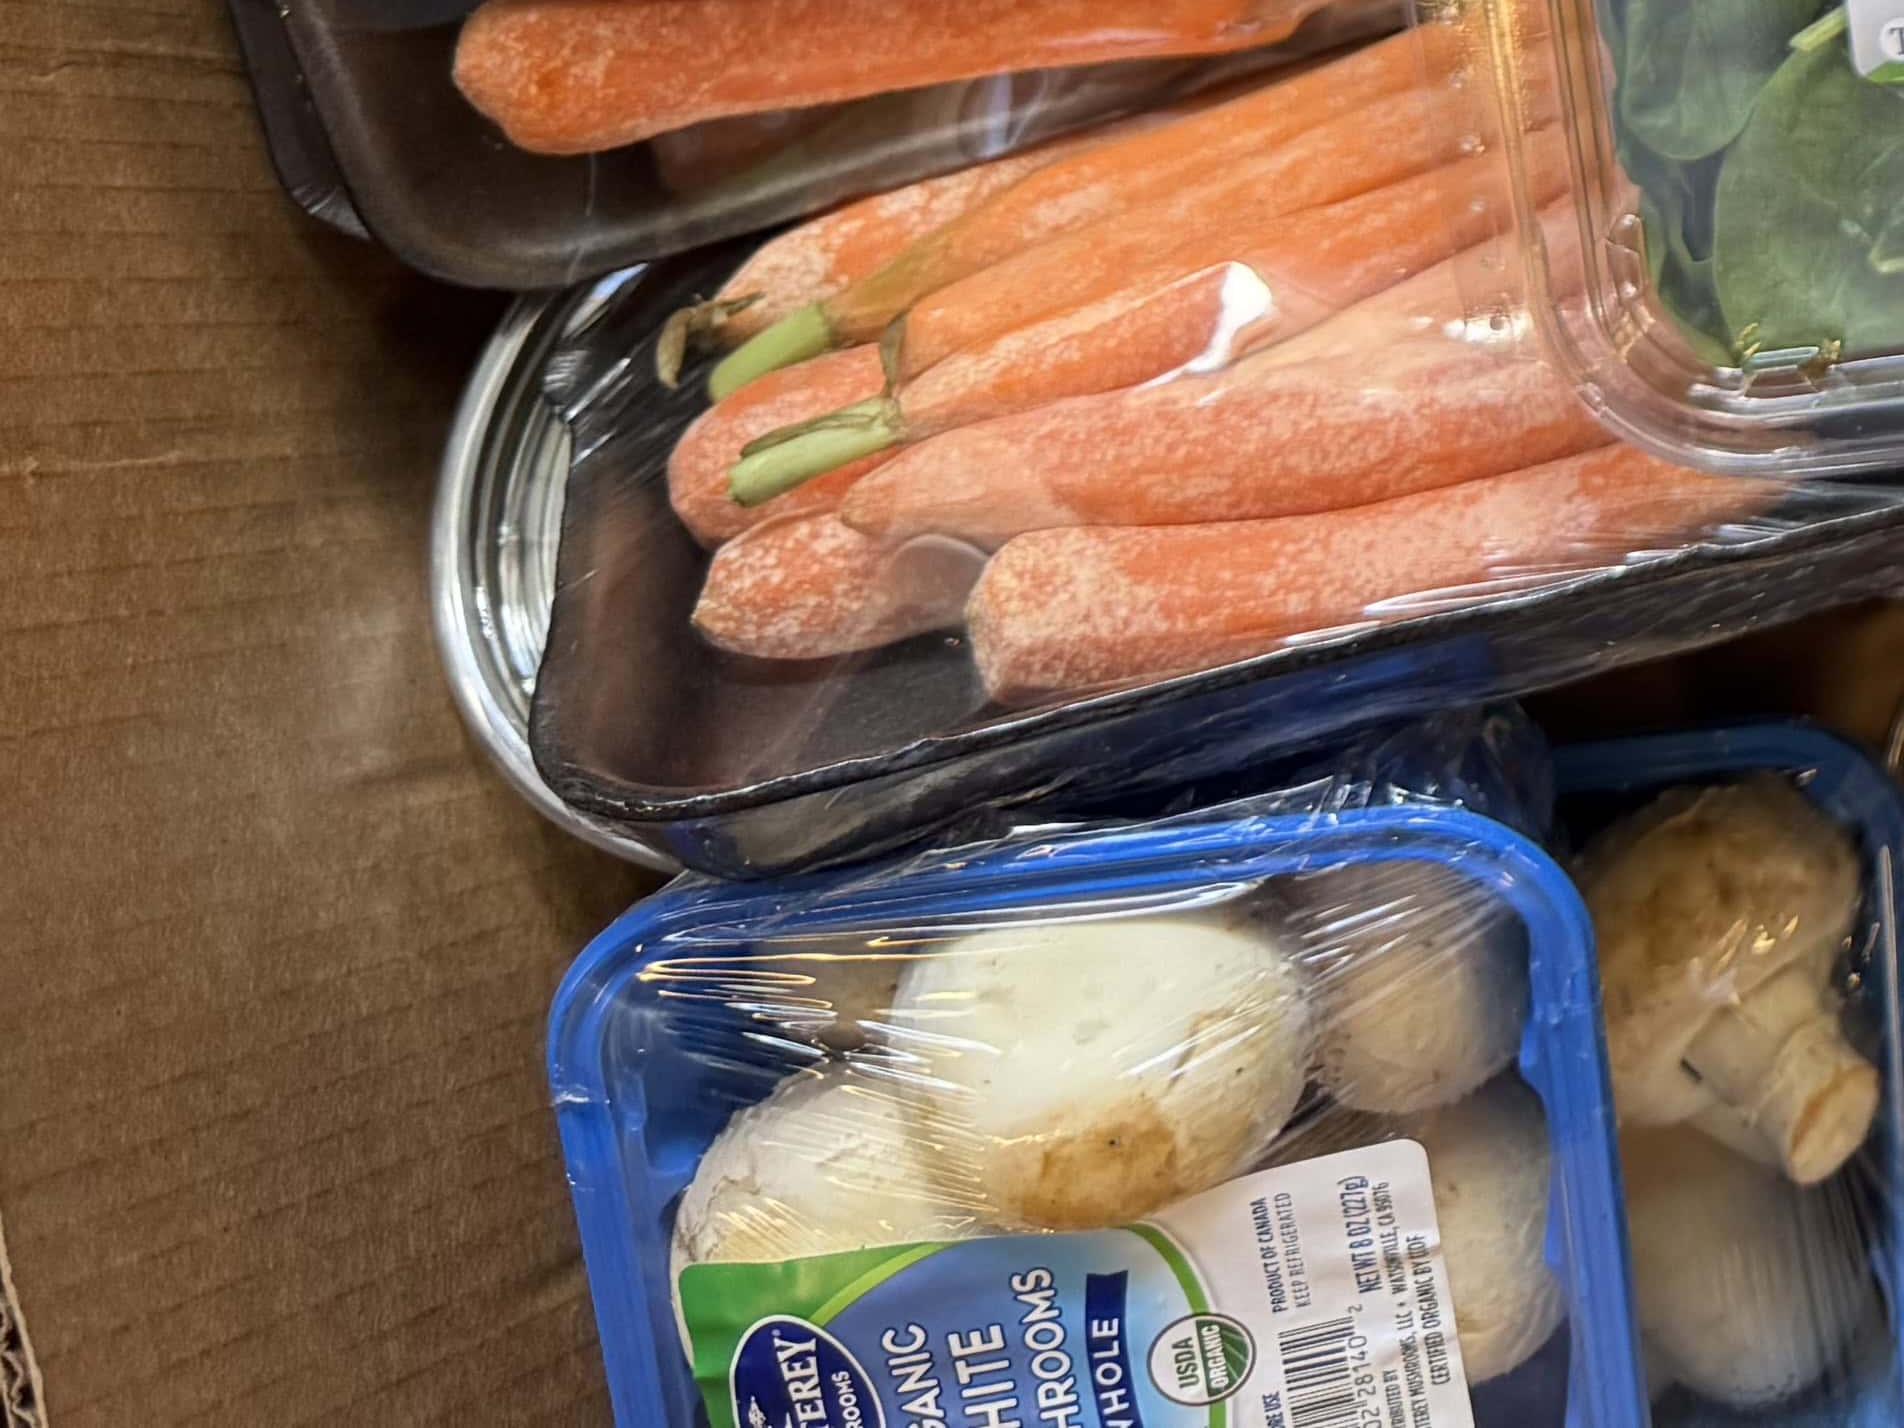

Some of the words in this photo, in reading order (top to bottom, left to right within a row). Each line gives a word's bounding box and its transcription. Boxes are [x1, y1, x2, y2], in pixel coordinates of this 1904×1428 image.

[1337, 1175, 1370, 1218] (227g)
[1249, 1197, 1273, 1243] CANADA
[1344, 1217, 1371, 1237] OZ
[1376, 1211, 1395, 1226] CA
[1274, 1193, 1298, 1276] REFRIGERATED
[1348, 1237, 1373, 1249] 8
[1259, 1245, 1277, 1259] OF
[1350, 1250, 1377, 1270] WT
[1354, 1269, 1382, 1293] NET
[1410, 1260, 1432, 1276] BY
[1266, 1261, 1289, 1314] PRODUCT
[1290, 1279, 1311, 1307] KEEP
[1346, 1303, 1363, 1313] 2
[1414, 1276, 1440, 1329] ORGANIC
[1394, 1309, 1414, 1330] LLC
[1171, 1336, 1199, 1388] USDA
[1201, 1324, 1229, 1387] ORGANIC
[1347, 1335, 1376, 1397] 28140
[1402, 1331, 1424, 1397] MUSHROOMS,
[1423, 1331, 1450, 1385] CERTIFIED
[1382, 1368, 1398, 1383] BY
[1261, 1390, 1281, 1412] USE
